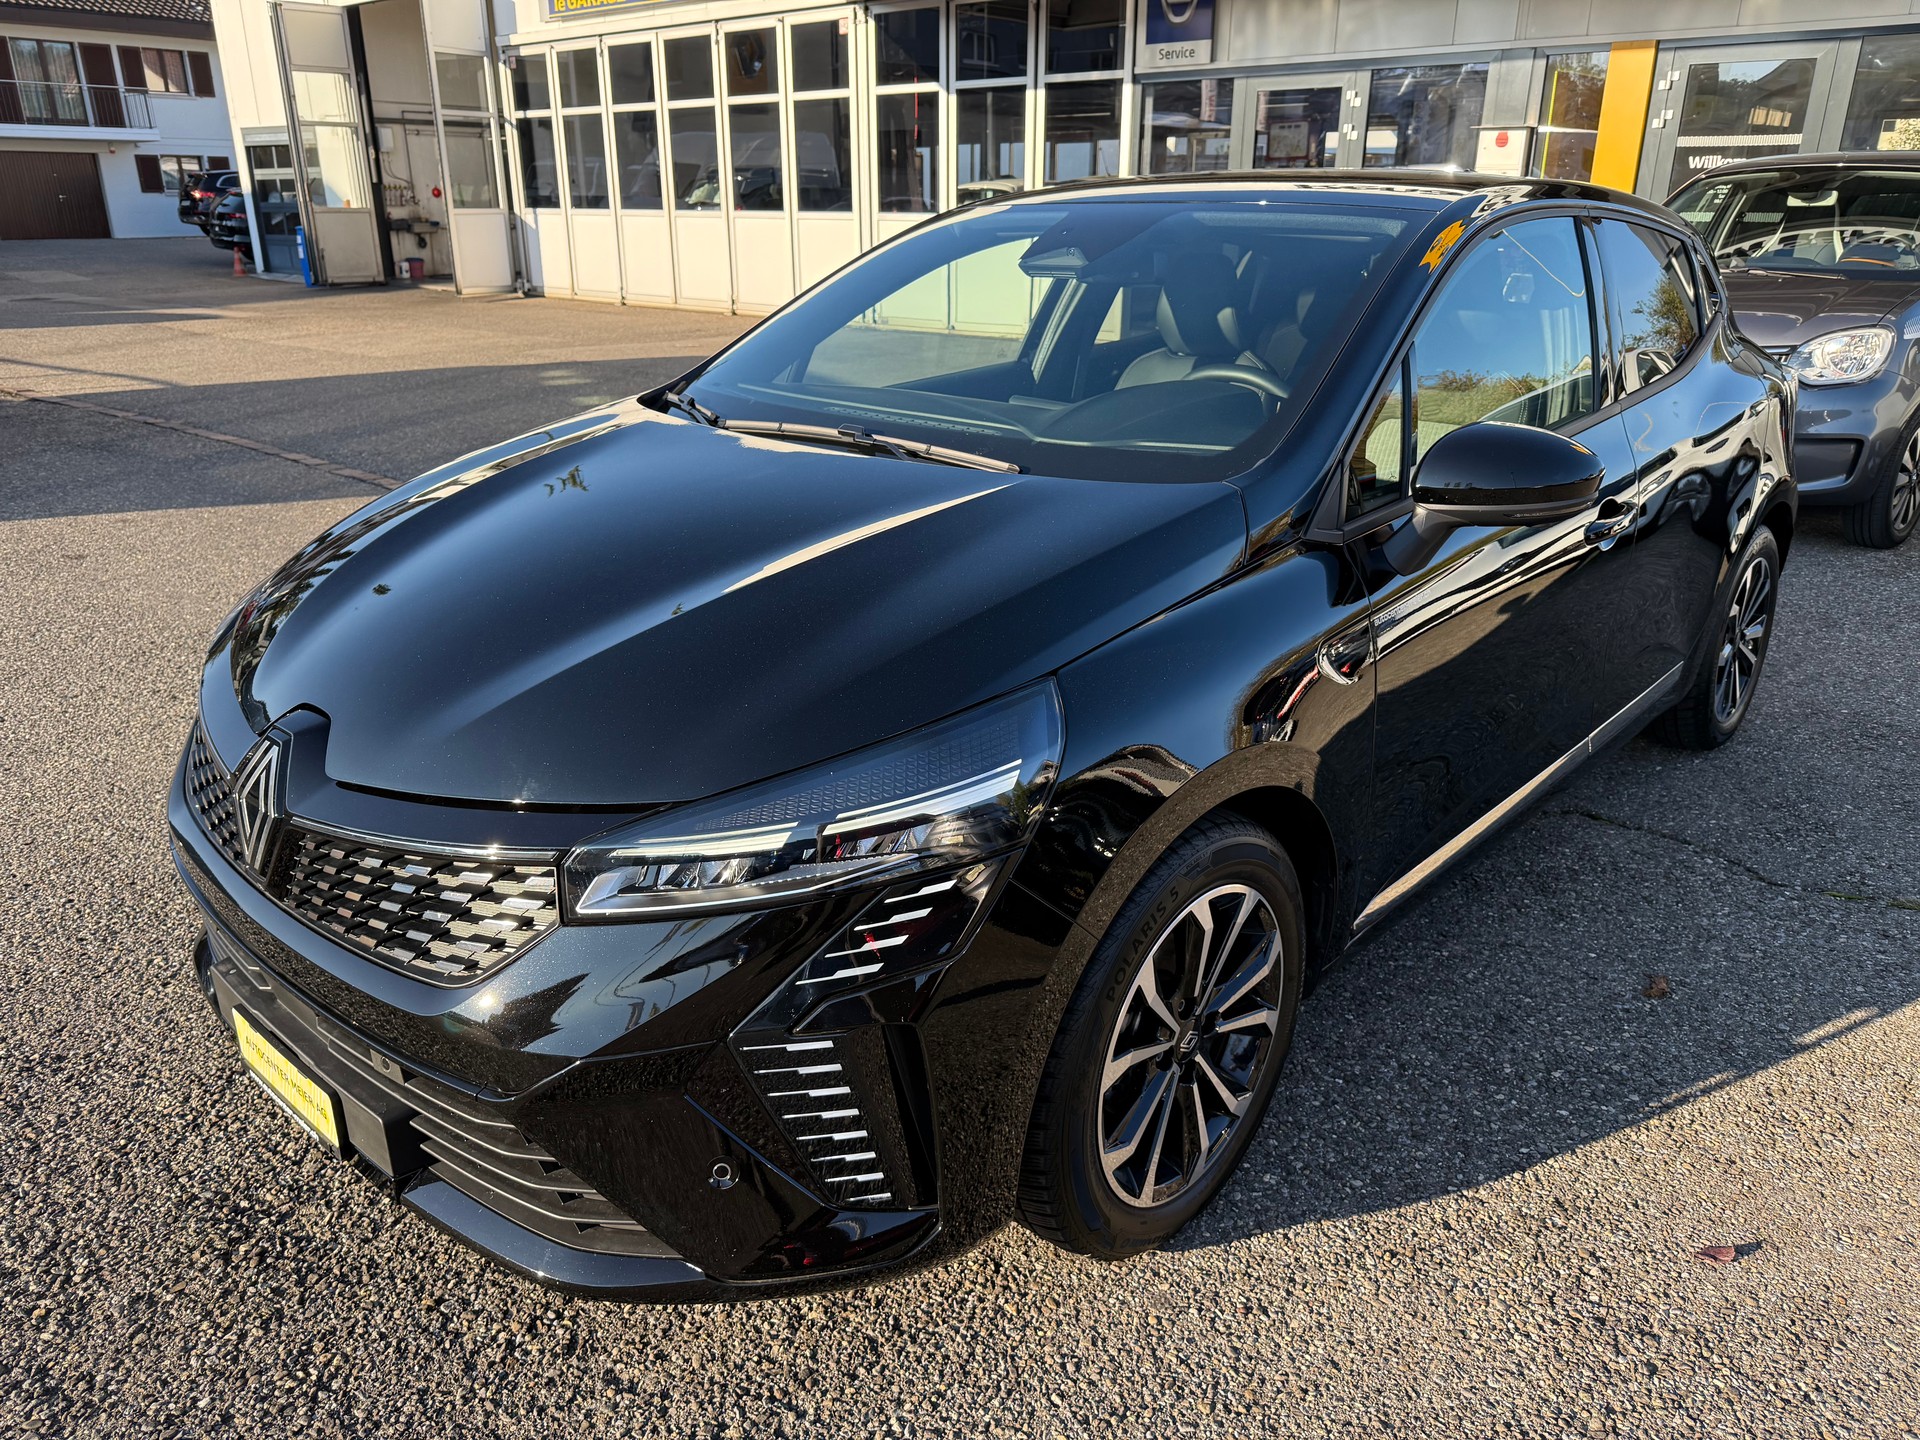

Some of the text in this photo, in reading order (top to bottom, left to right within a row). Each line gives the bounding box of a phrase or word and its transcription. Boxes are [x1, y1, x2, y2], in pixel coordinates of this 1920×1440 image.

[1158, 46, 1195, 60] Service
[1106, 901, 1167, 1003] POLARIS
[245, 1035, 290, 1084] AUTOCENTER
[289, 1079, 315, 1109] MEIER
